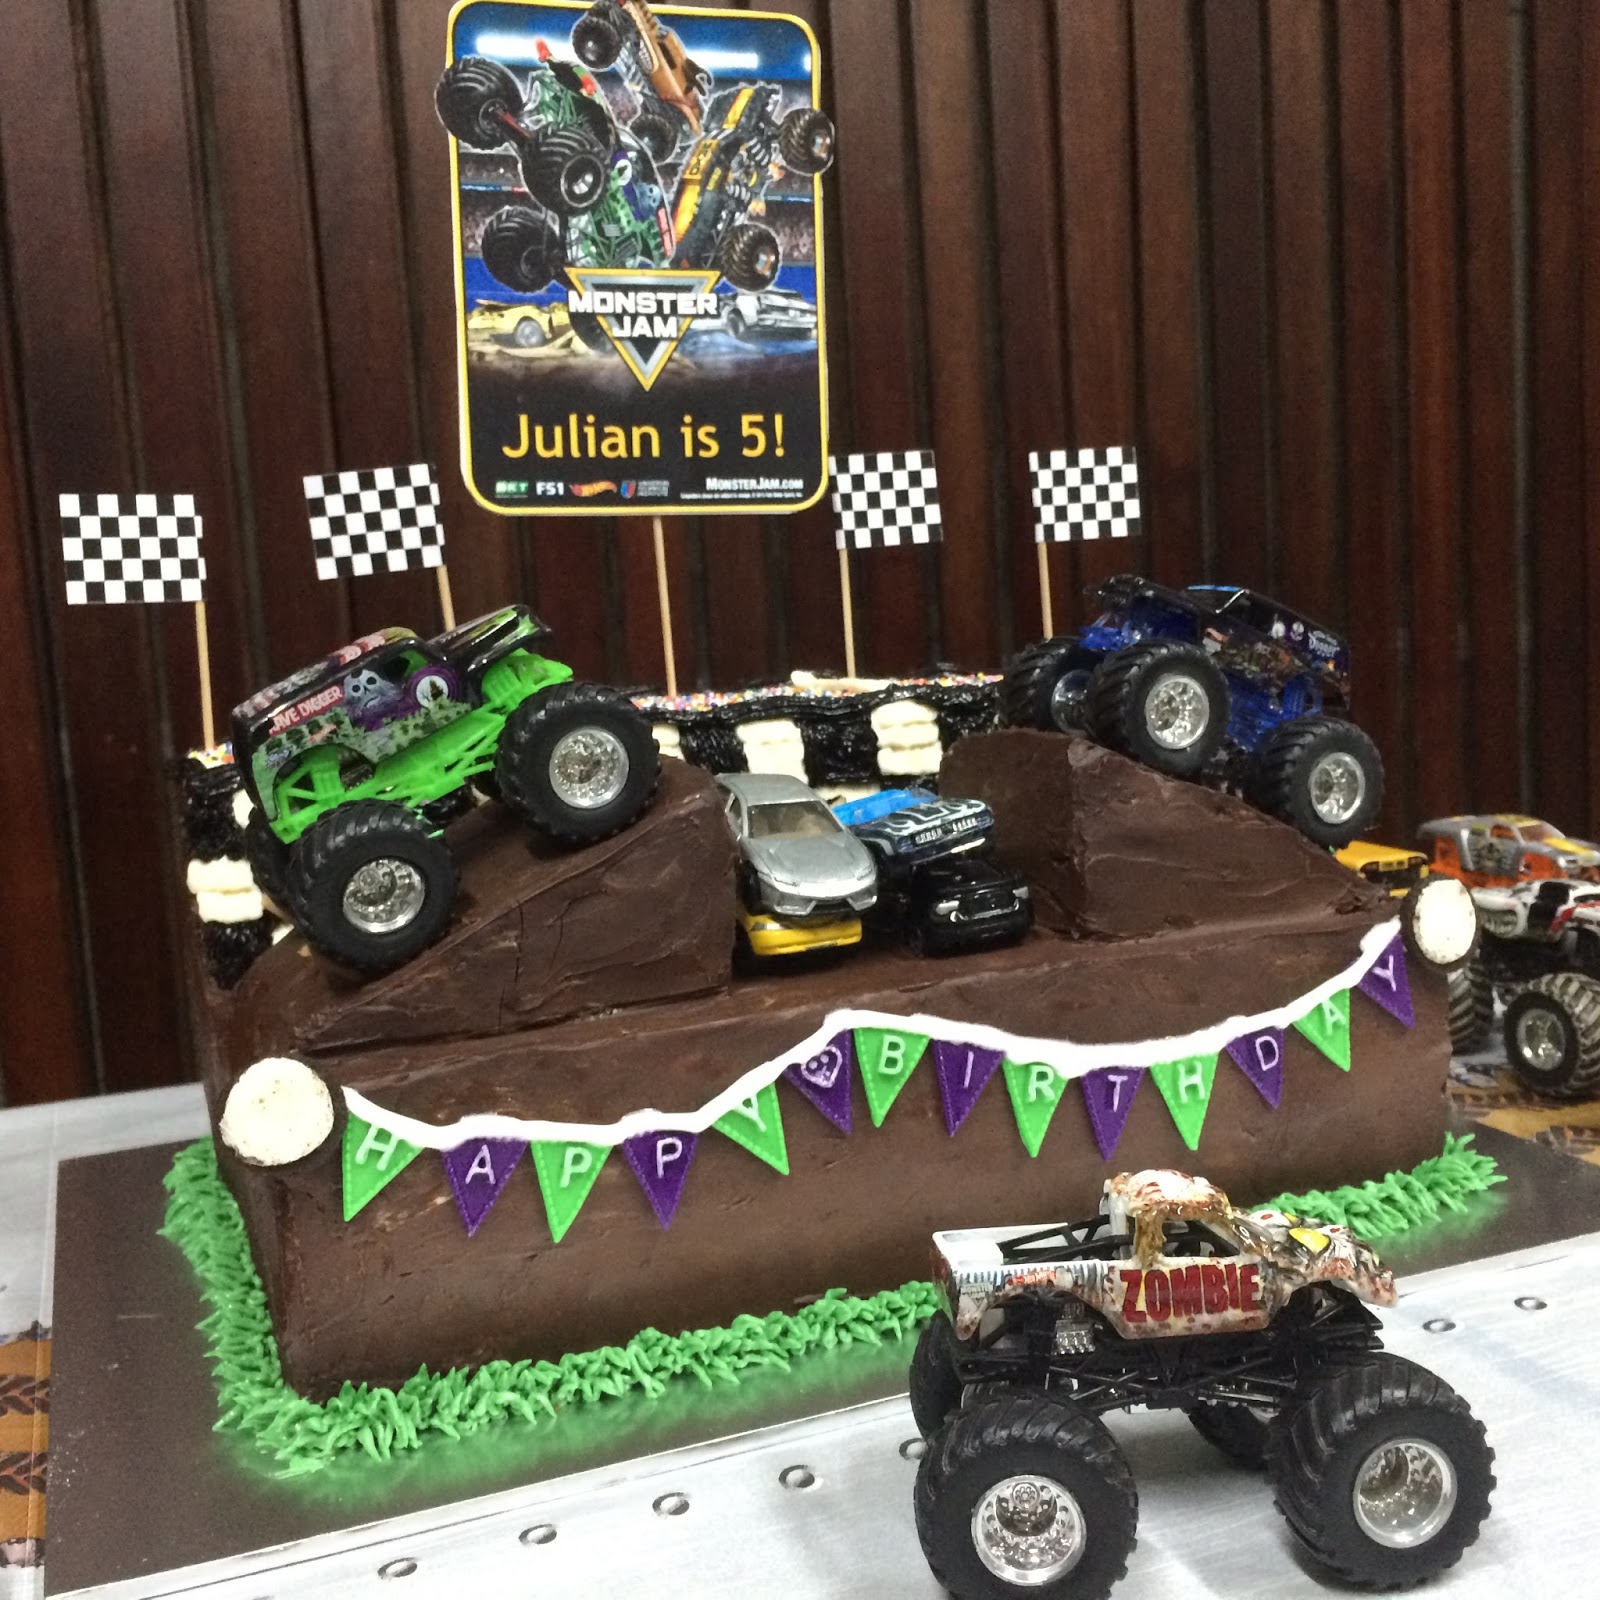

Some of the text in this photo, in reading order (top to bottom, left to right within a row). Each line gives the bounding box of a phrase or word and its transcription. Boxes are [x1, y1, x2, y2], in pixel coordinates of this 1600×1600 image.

[568, 290, 718, 315] MONSTER
[612, 315, 678, 338] JAM
[502, 413, 785, 458] Julian is 5!
[535, 481, 565, 496] FS1
[297, 685, 343, 717] DIGGER
[1119, 1263, 1261, 1323] ZOMBIE
